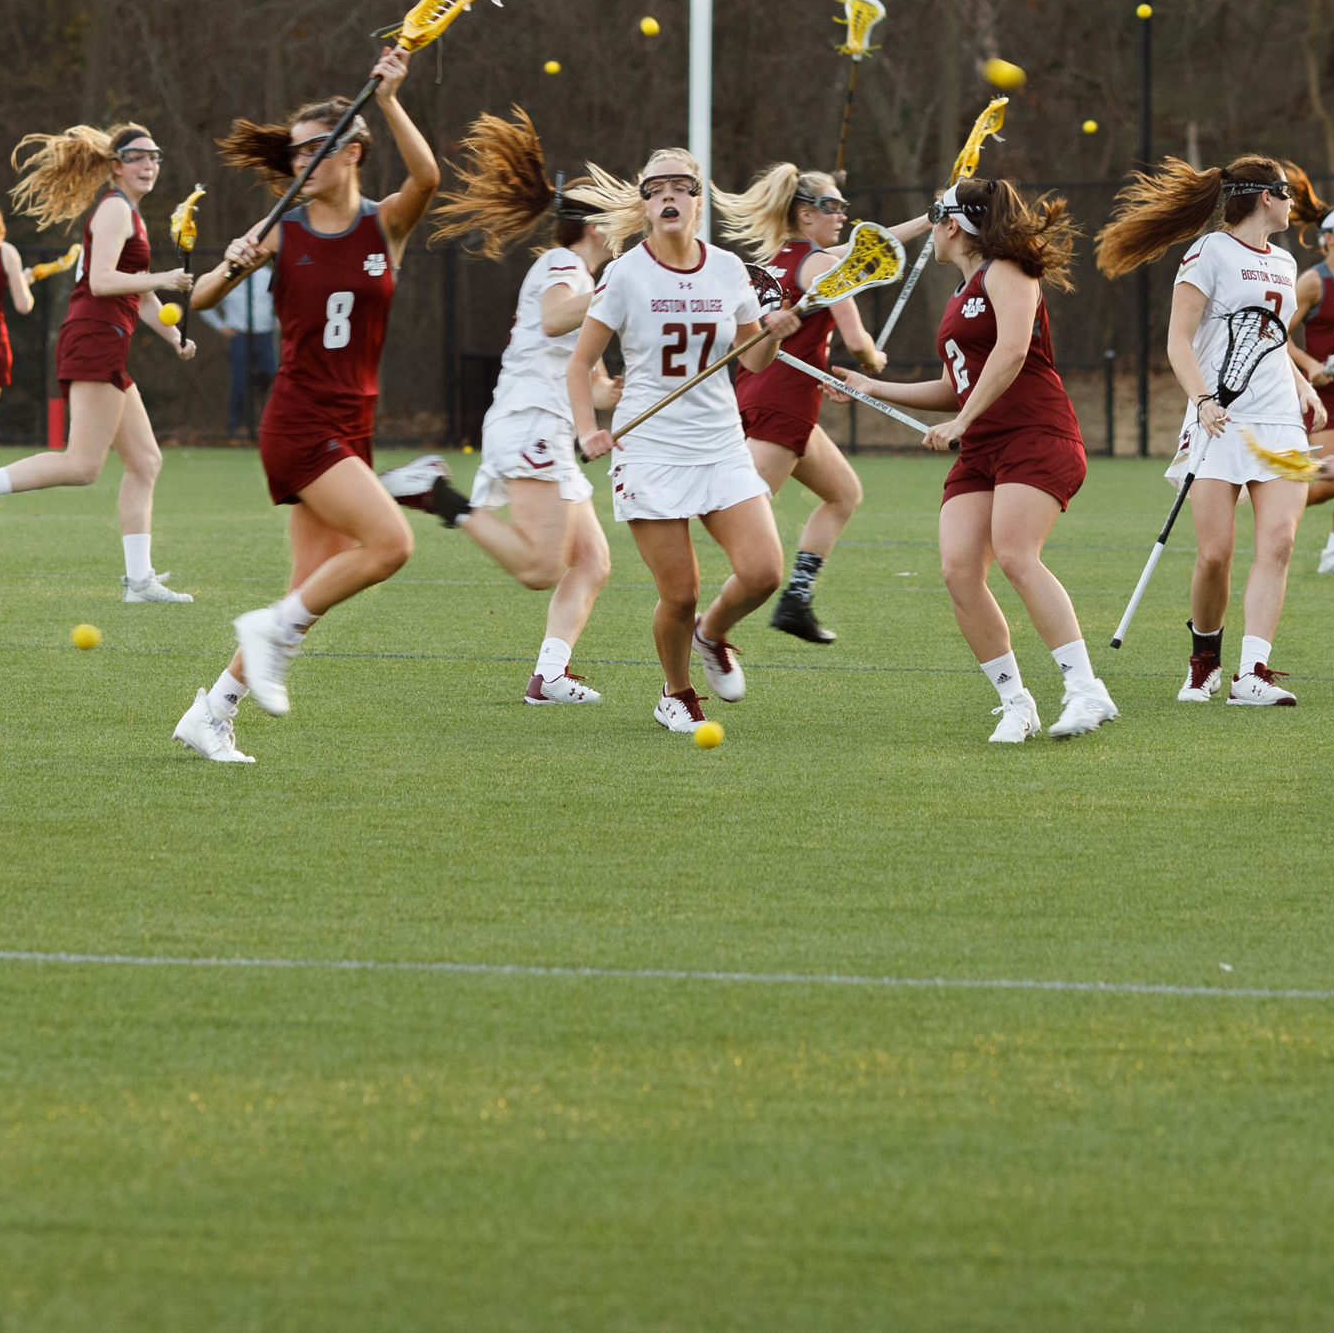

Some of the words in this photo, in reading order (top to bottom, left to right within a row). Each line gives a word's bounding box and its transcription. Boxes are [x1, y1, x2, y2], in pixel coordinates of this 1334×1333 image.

[1241, 269, 1270, 282] BOSTON
[323, 291, 355, 349] 8
[651, 299, 687, 313] BOSTON
[690, 299, 723, 313] COLLEGE
[662, 322, 717, 377] 27
[945, 338, 970, 394] 2
